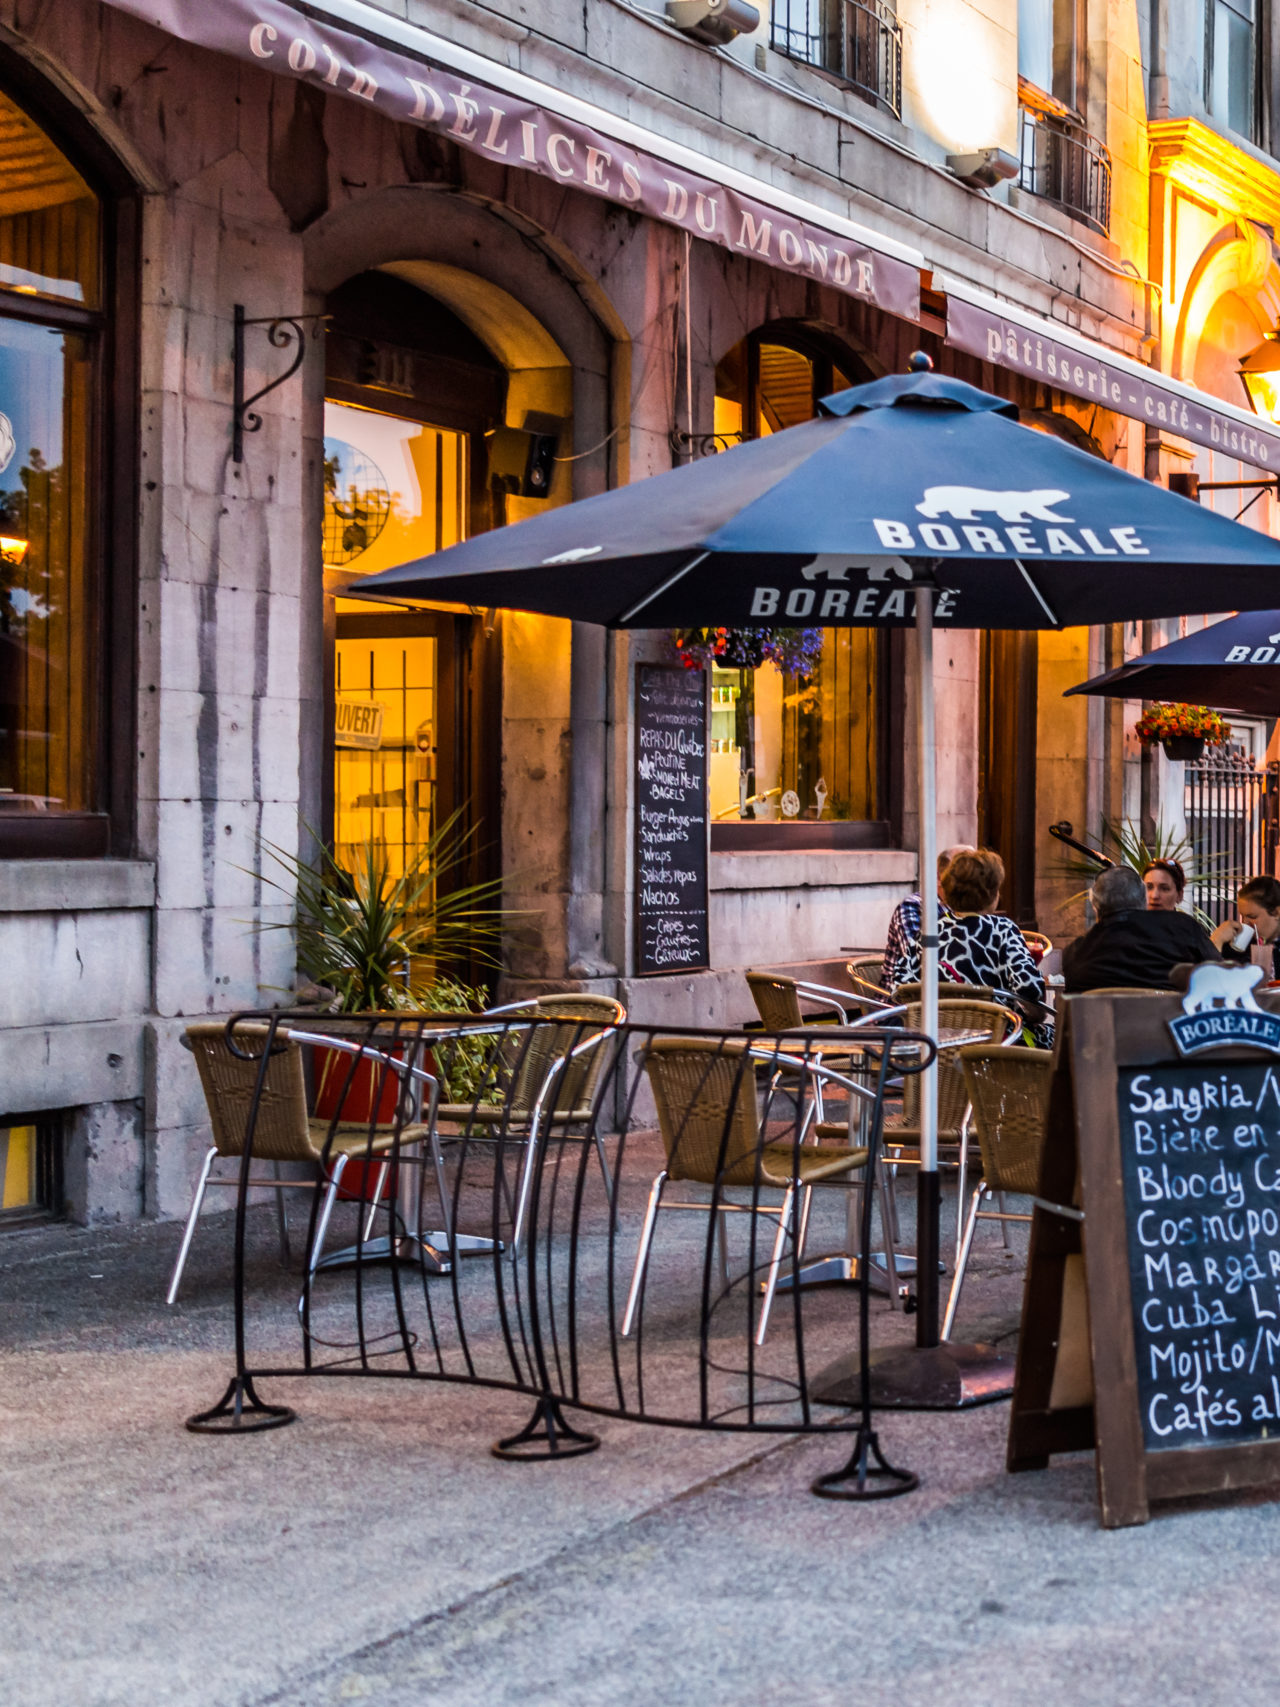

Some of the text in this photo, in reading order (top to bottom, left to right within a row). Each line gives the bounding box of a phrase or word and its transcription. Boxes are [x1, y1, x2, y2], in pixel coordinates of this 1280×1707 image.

[405, 77, 643, 202] DÉLICES
[662, 178, 718, 234] DU
[737, 211, 877, 298] MONDE
[986, 327, 1121, 403] pâtisserie
[1144, 395, 1189, 431] café
[1209, 418, 1270, 463] bistro
[872, 518, 1151, 555] BORÉALE
[750, 587, 961, 618] BORÉAE
[335, 702, 380, 735] UVERT
[643, 846, 671, 865] Wraps
[642, 885, 680, 907] Nachos
[1180, 1013, 1280, 1043] BORÉALE
[1233, 1123, 1268, 1148] en
[1137, 1159, 1246, 1209] Bloody
[1142, 1290, 1237, 1333] Cuba
[1149, 1384, 1242, 1437] Cafés
